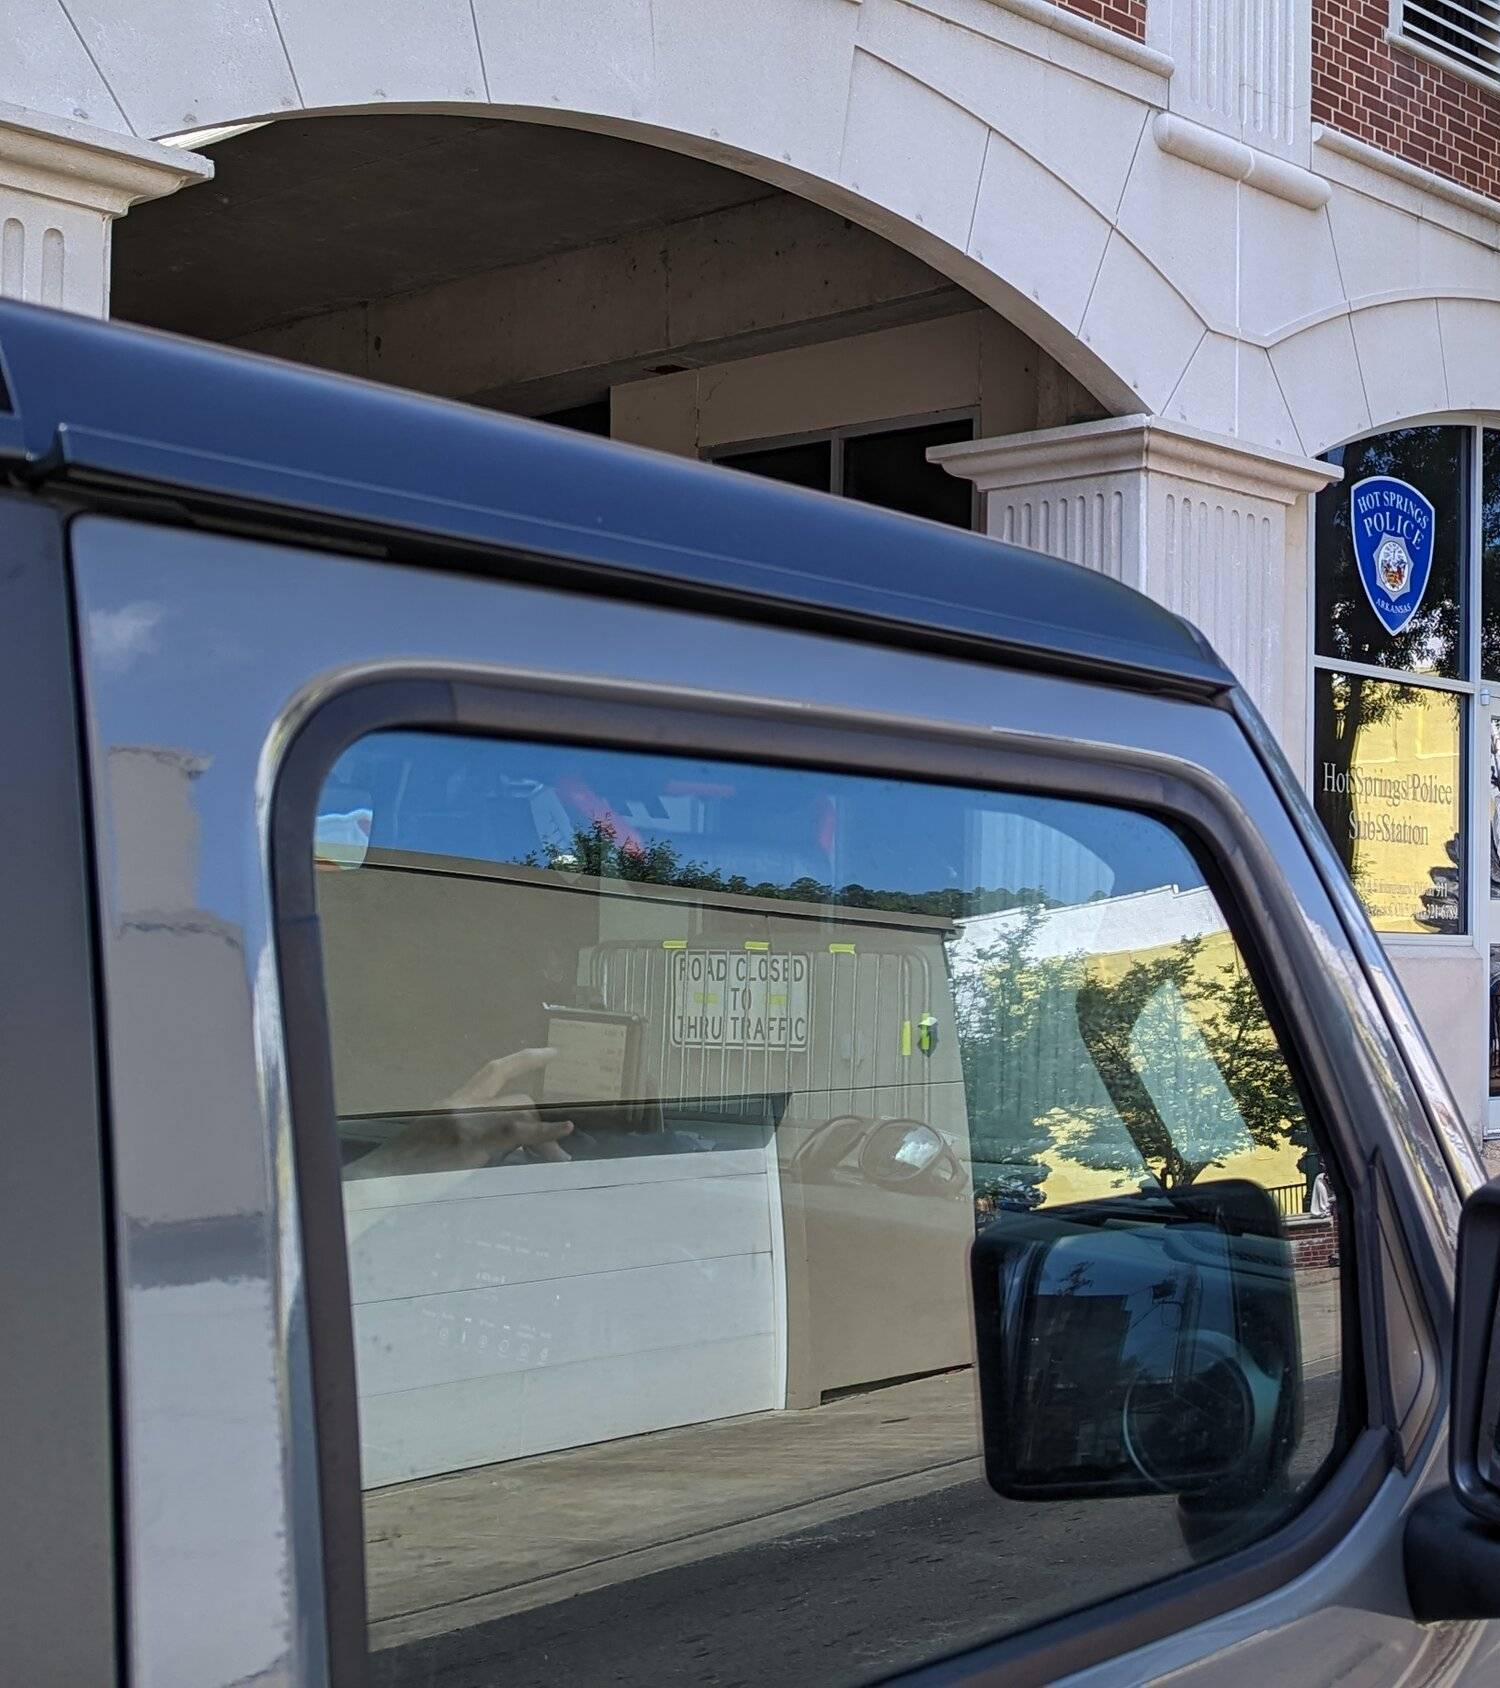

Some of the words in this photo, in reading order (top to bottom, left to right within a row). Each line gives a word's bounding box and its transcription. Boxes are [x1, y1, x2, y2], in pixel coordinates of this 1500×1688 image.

[1357, 492, 1381, 514] HOT
[1383, 491, 1429, 529] SPRINGS
[1363, 512, 1425, 550] POLICE
[1376, 598, 1412, 614] ARKANSAS
[1323, 762, 1350, 793] Hot
[1350, 766, 1408, 807] Springs
[1407, 773, 1453, 805] Police
[1349, 810, 1428, 845] Sub-Station
[730, 987, 752, 1011] TO
[677, 1015, 722, 1039] THRU
[730, 1016, 806, 1041] TRAFFIC
